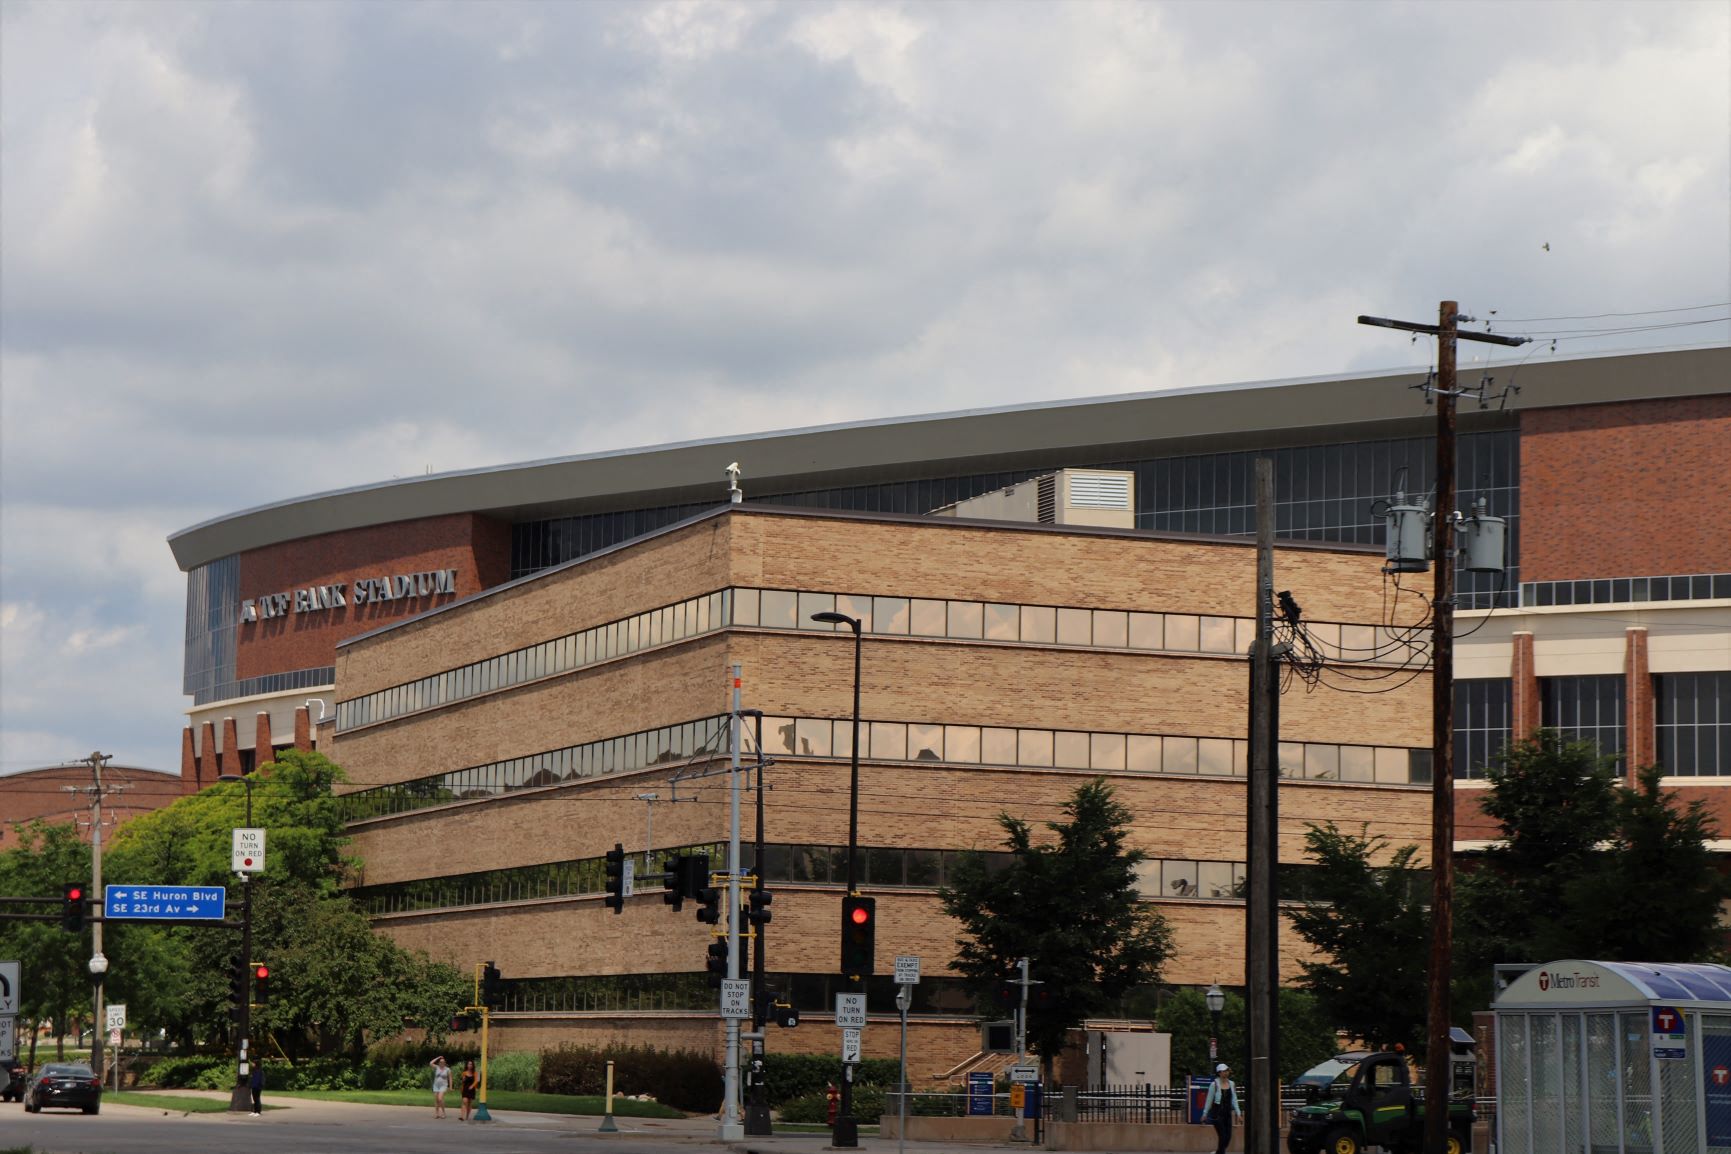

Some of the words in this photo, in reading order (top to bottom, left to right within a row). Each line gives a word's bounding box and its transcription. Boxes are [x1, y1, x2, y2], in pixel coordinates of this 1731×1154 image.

[259, 592, 290, 619] TCF
[293, 583, 347, 613] BANK
[353, 569, 457, 604] STADIUM
[133, 891, 148, 900] SE
[153, 891, 188, 900] Huron
[192, 892, 218, 901] Blvd
[113, 904, 128, 913] SE
[133, 904, 160, 913] 23rd
[165, 904, 180, 913] Av
[722, 1007, 748, 1015] TRACKS
[109, 1017, 124, 1026] 30
